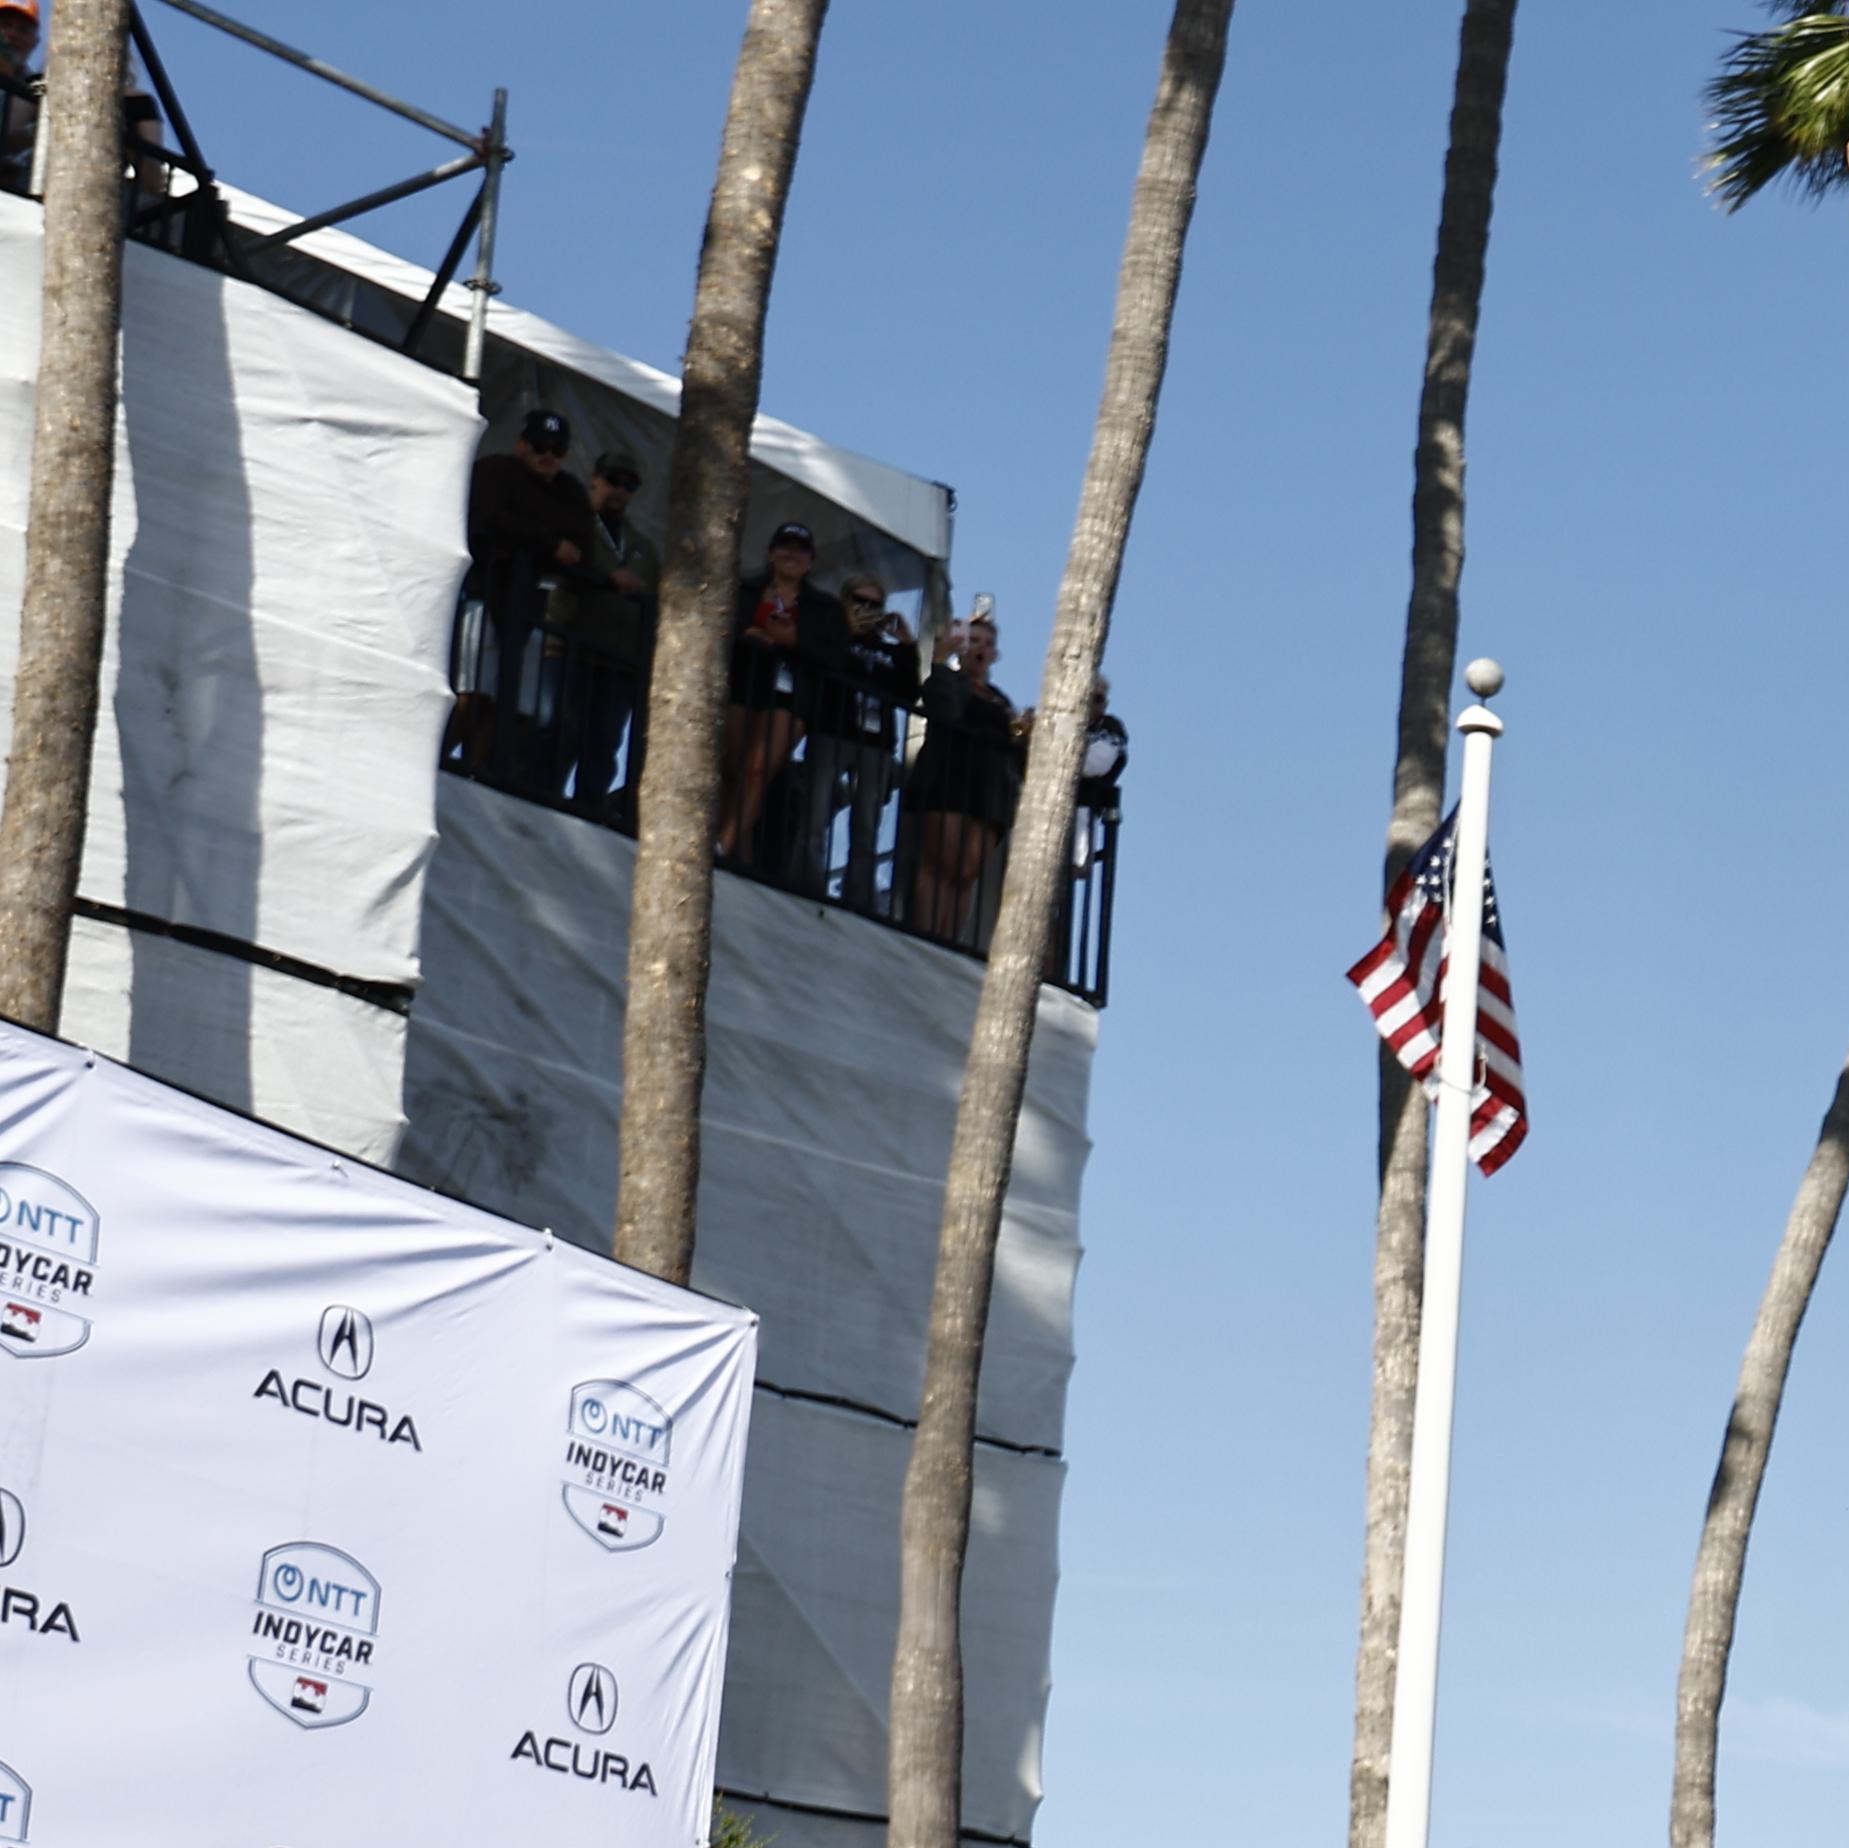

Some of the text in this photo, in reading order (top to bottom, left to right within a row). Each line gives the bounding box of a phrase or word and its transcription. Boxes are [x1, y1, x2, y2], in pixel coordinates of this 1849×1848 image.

[16, 1203, 84, 1245] NTT
[253, 1369, 422, 1452] ACURA
[611, 1413, 664, 1450] NTT
[566, 1440, 667, 1494] INDYCAR
[584, 1473, 645, 1502] SERIES
[308, 1578, 369, 1618] NTT
[252, 1610, 374, 1666] INDYCAR
[276, 1644, 346, 1675] SERIES
[510, 1730, 659, 1797] ACURA
